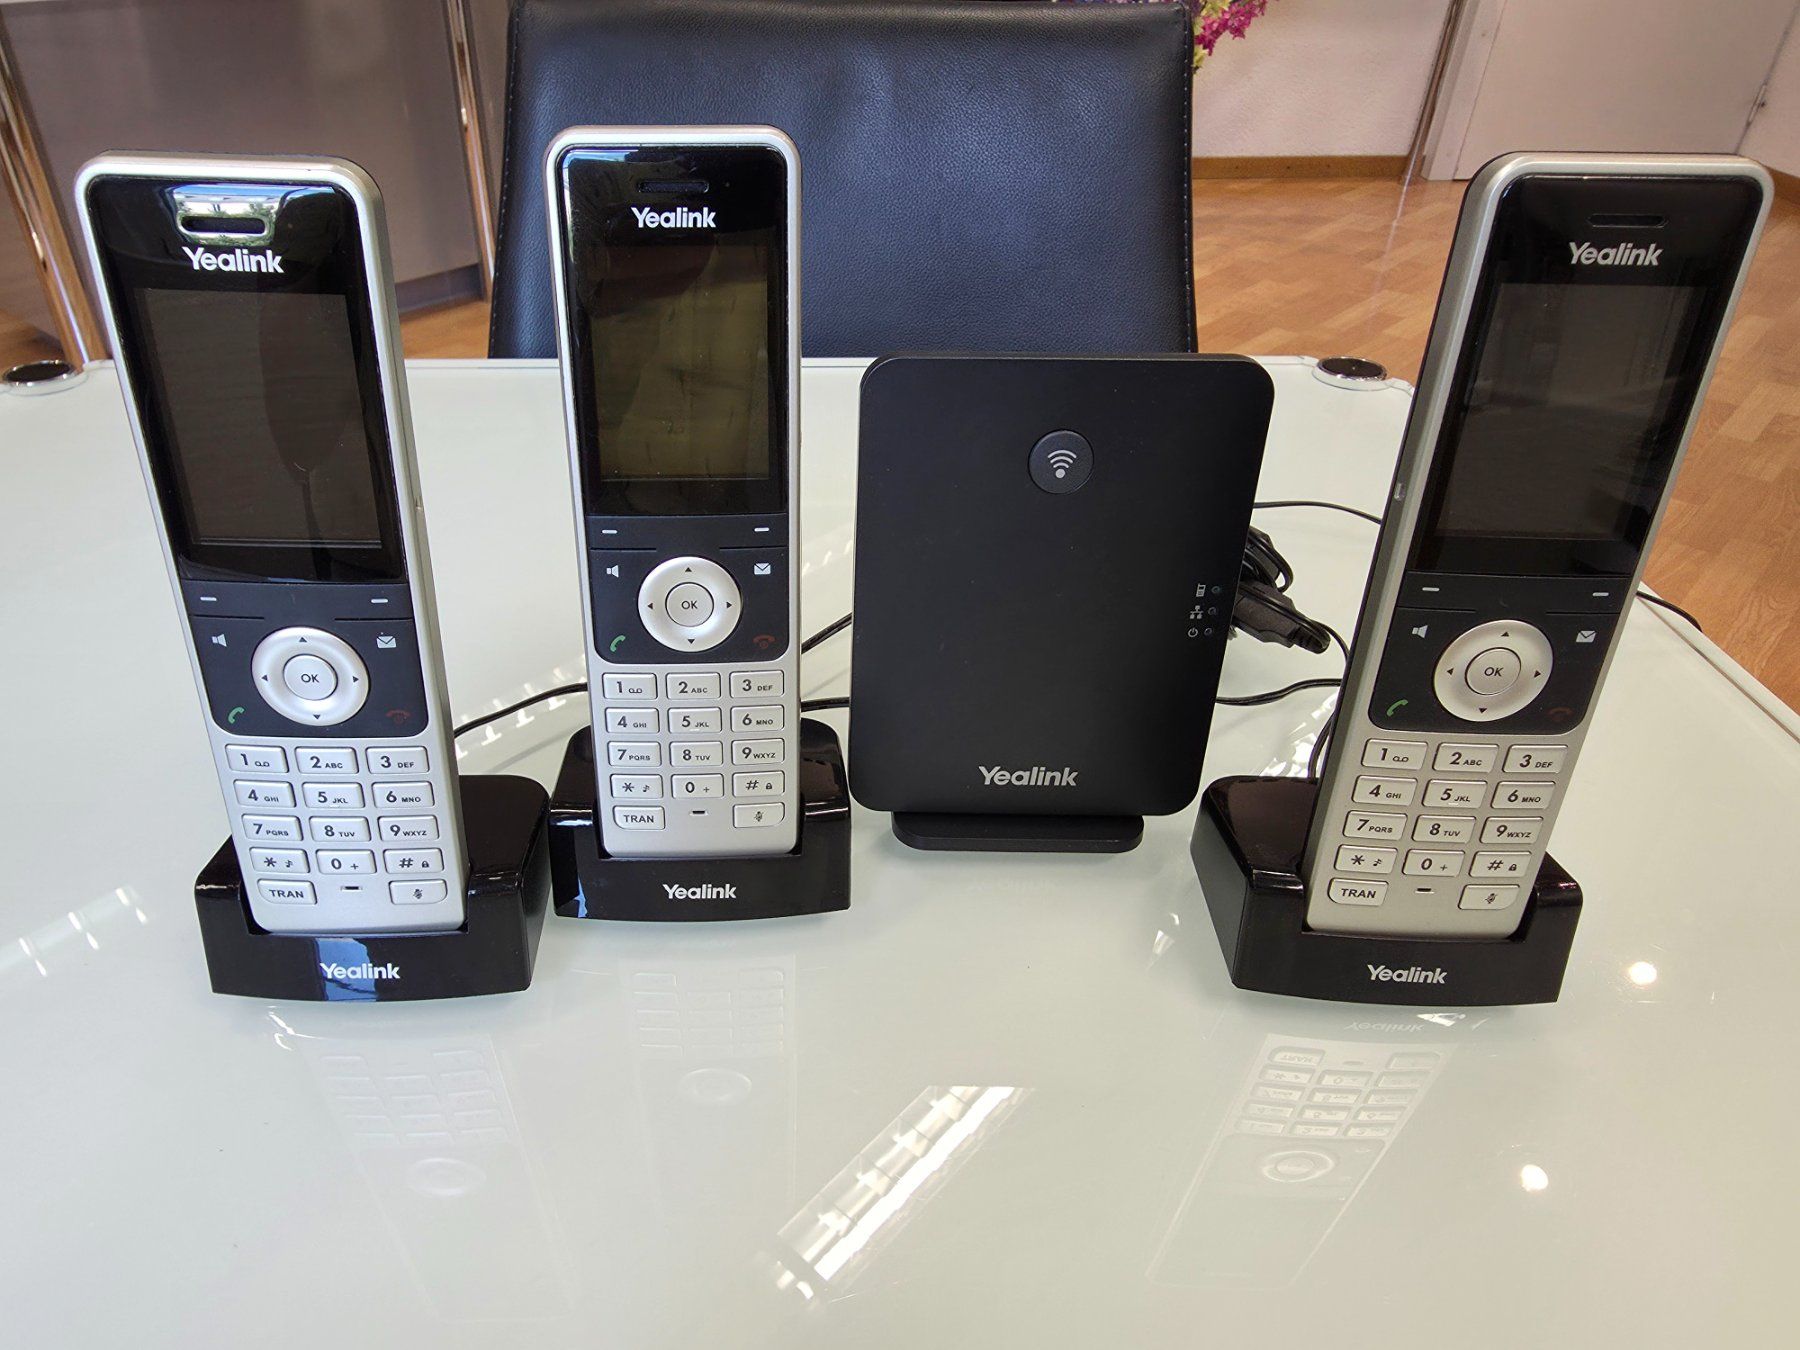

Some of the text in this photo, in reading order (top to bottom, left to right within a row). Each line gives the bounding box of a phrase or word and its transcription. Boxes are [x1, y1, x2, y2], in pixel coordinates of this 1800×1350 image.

[631, 207, 716, 228] Yealink
[182, 246, 284, 273] Yealink
[1569, 242, 1664, 266] Yealink
[681, 601, 698, 610] OK
[1484, 667, 1504, 677] OK
[301, 674, 319, 683] OK
[616, 682, 622, 693] 1
[678, 682, 688, 694] 2
[742, 679, 752, 692] 3
[618, 716, 627, 728] 4
[682, 716, 690, 728] 5
[742, 714, 752, 726] 6
[618, 749, 627, 761] 7
[683, 749, 691, 761] 8
[742, 747, 752, 759] 9
[1381, 748, 1387, 760] 1
[1450, 752, 1462, 764] 2
[241, 754, 249, 766] 1
[310, 756, 321, 769] 2
[381, 756, 391, 768] 3
[1520, 755, 1532, 767] 3
[979, 766, 1078, 786] Yealink
[685, 782, 695, 793] 0
[1369, 785, 1380, 797] 4
[248, 790, 258, 801] 4
[318, 792, 327, 803] 5
[386, 791, 397, 802] 6
[1441, 788, 1452, 800] 5
[1508, 790, 1518, 802] 6
[624, 815, 654, 823] TRAN
[1358, 819, 1369, 831] 7
[253, 824, 263, 835] 7
[325, 825, 334, 836] 8
[390, 825, 400, 836] 9
[1430, 823, 1440, 835] 8
[1496, 825, 1507, 837] 9
[331, 858, 342, 870] 0
[1421, 858, 1432, 870] 0
[270, 889, 304, 898] TRAN
[663, 884, 737, 899] Yealink
[1341, 889, 1376, 898] TRAN
[320, 962, 400, 979] Yealink
[1367, 964, 1448, 984] Yealink
